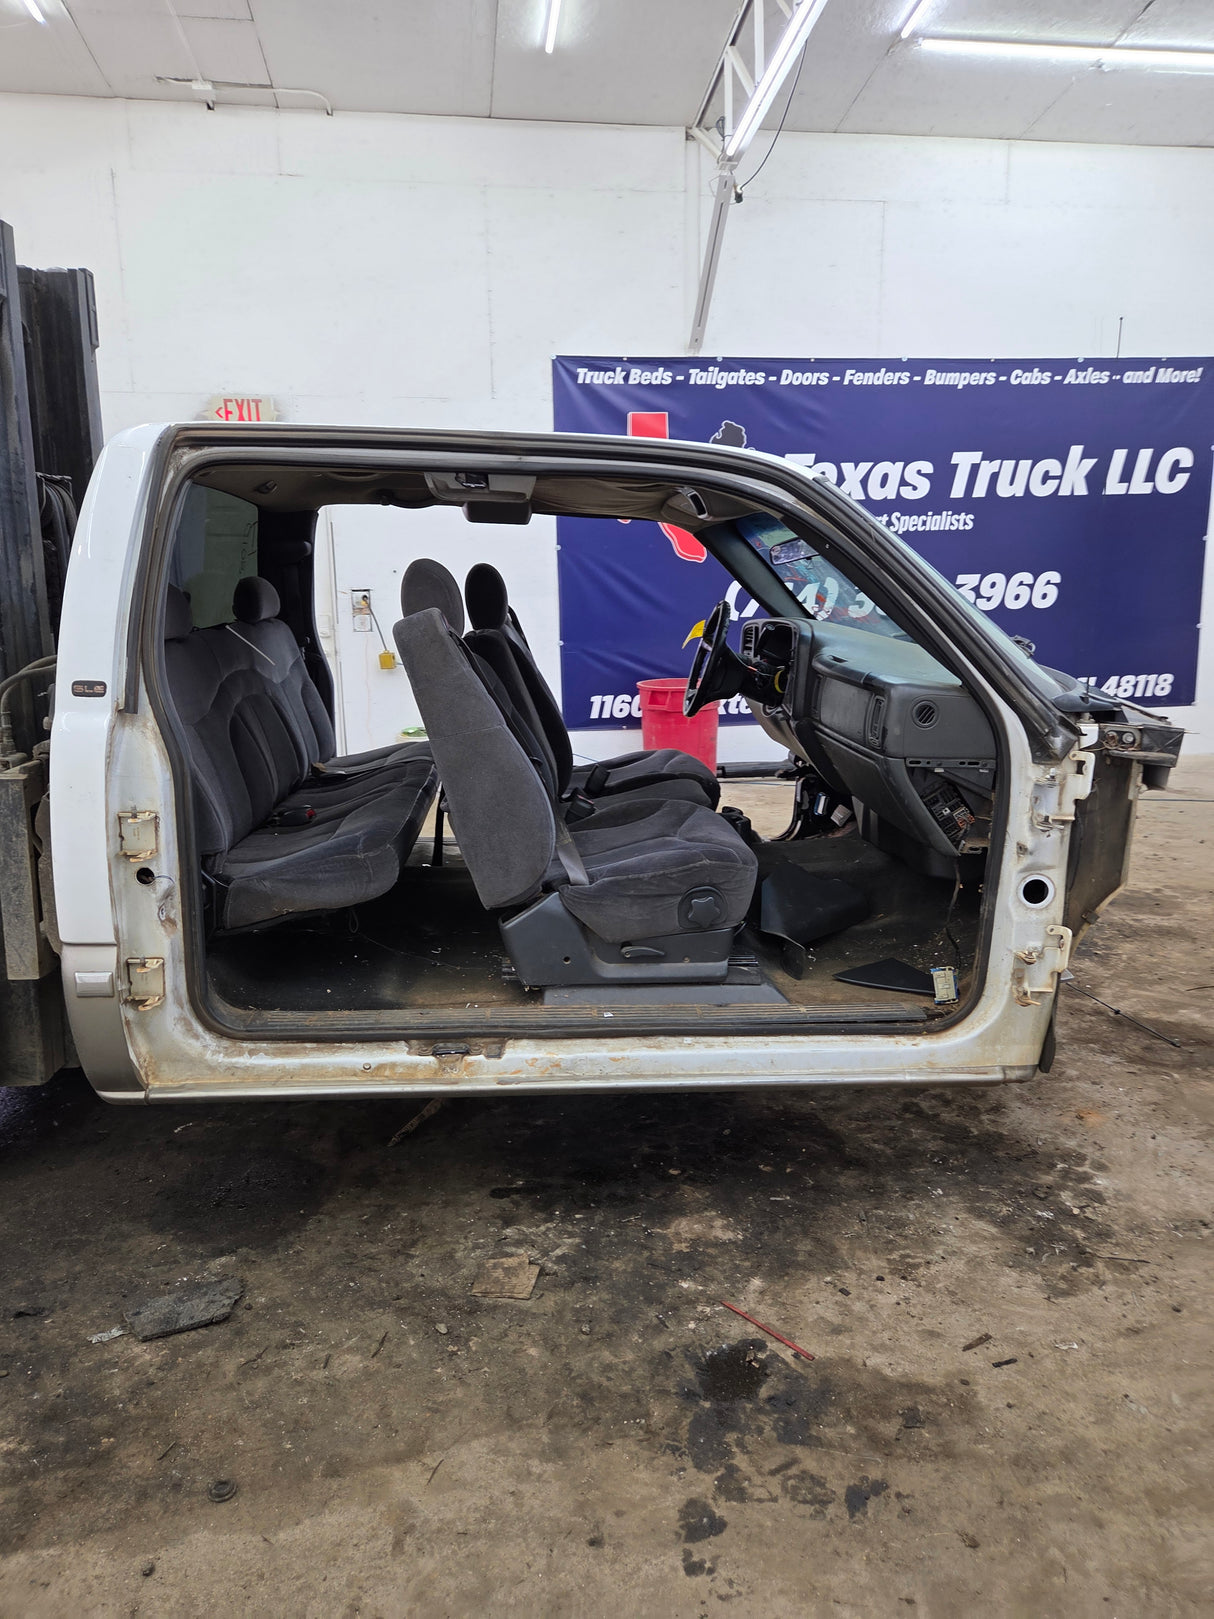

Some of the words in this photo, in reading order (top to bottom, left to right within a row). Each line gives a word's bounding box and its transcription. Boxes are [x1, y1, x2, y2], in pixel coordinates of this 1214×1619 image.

[576, 367, 627, 385] Truck
[628, 367, 673, 385] Beds
[688, 366, 766, 390] Tailgates
[780, 369, 830, 386] Doors
[843, 367, 911, 386] Fenders
[923, 369, 997, 390] Bumpers
[1010, 369, 1052, 386] Cabs
[1063, 367, 1111, 385] Axles
[1122, 366, 1156, 384] and
[1155, 367, 1204, 384] More!
[223, 398, 262, 421] EXIT
[949, 445, 1099, 498] Truck
[1102, 446, 1194, 495] LLC
[889, 510, 975, 534] Specialists
[73, 684, 105, 694] SLE
[1100, 673, 1175, 698] 48118
